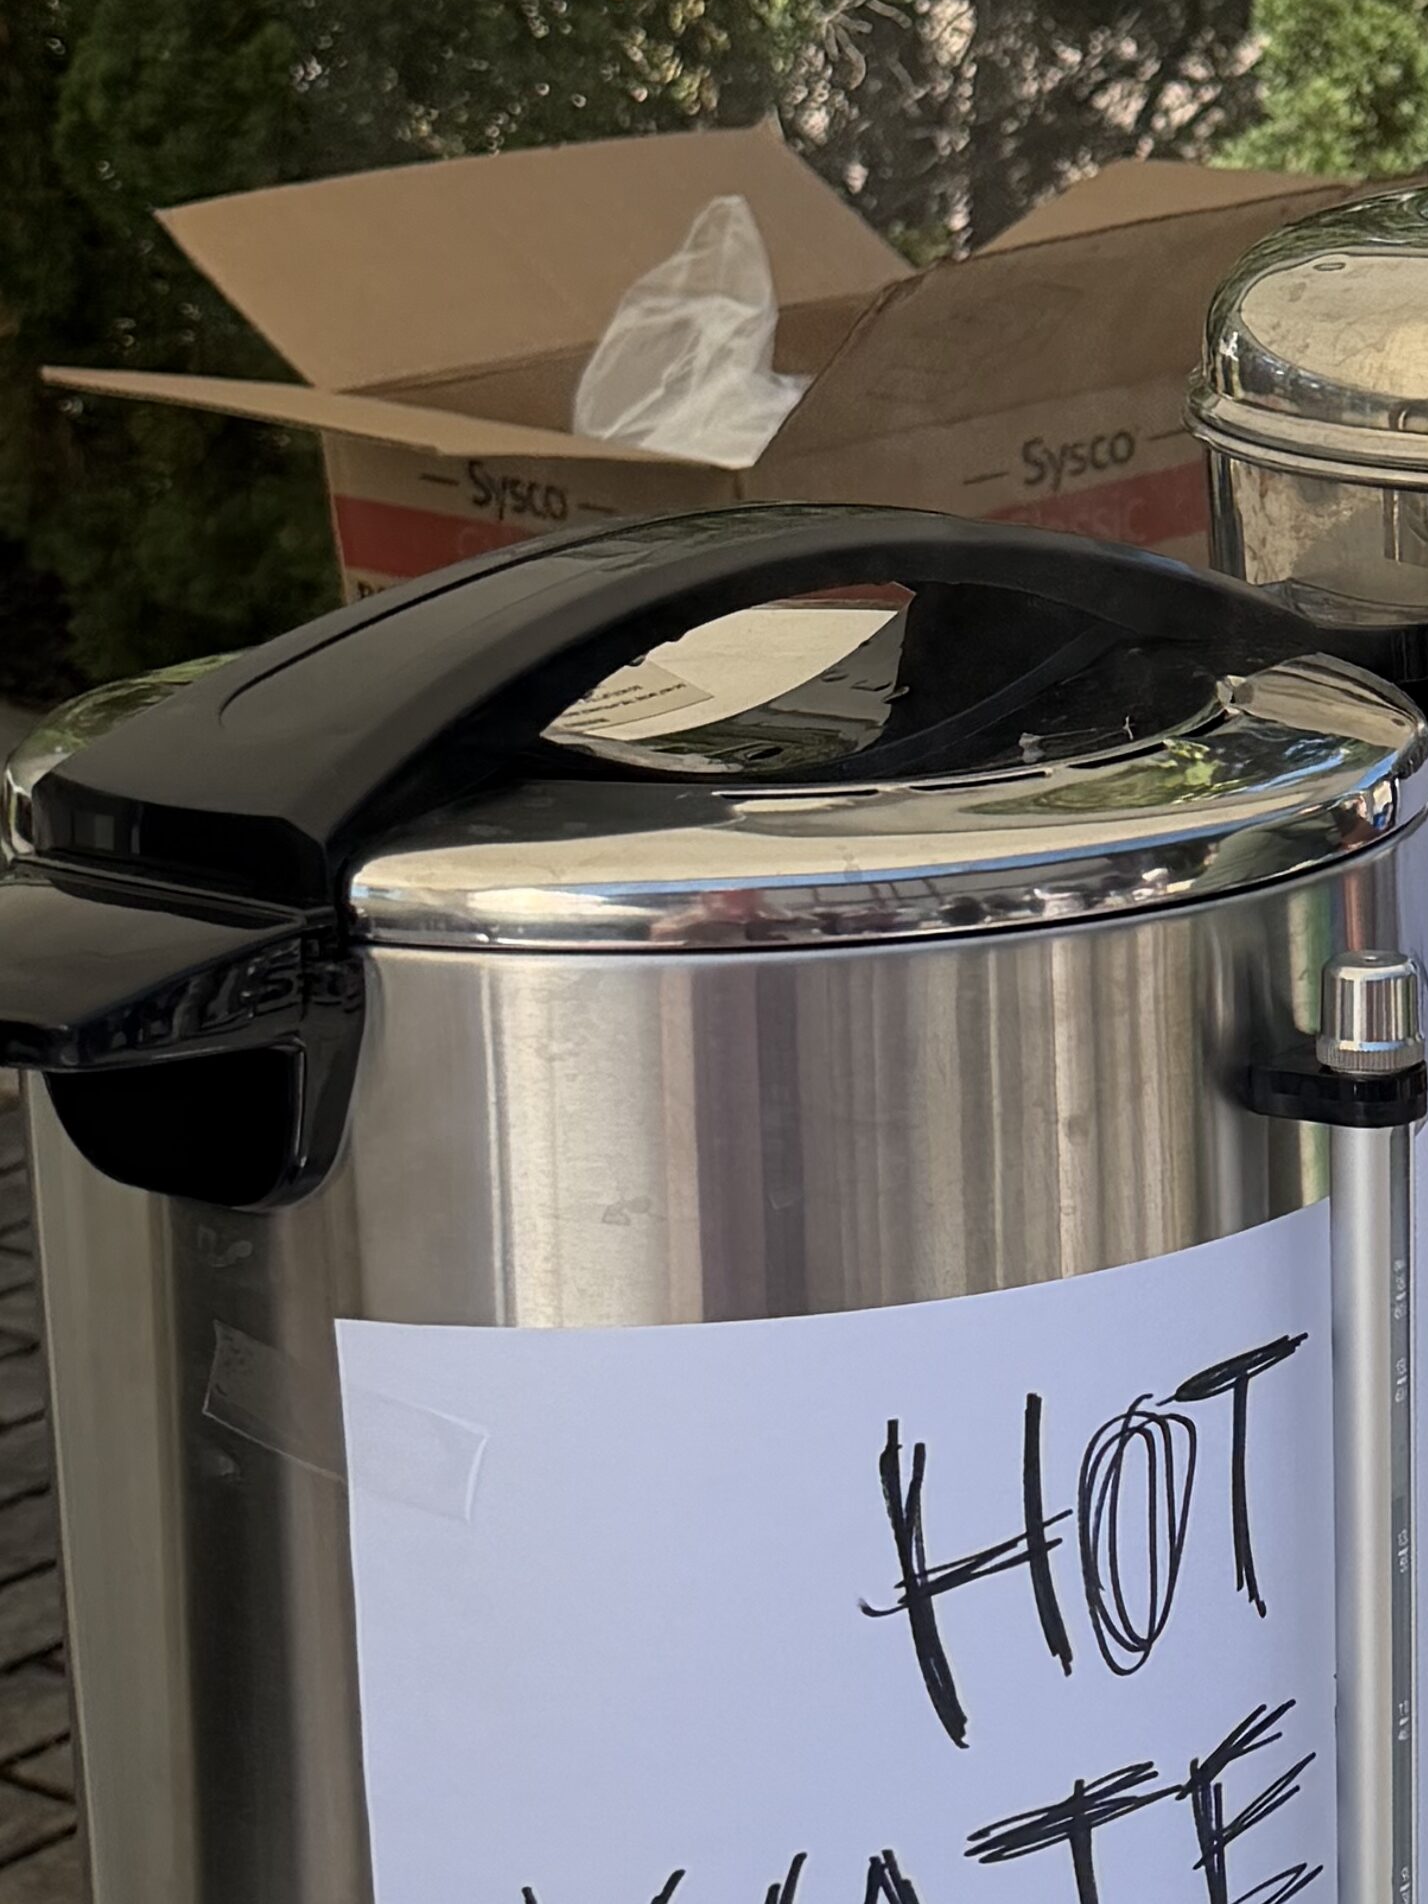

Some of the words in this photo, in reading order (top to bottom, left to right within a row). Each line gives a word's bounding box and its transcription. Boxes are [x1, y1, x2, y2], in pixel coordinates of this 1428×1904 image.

[467, 460, 569, 521] Sysco
[1020, 430, 1136, 492] Sysco
[858, 1332, 1308, 1751] HOT
